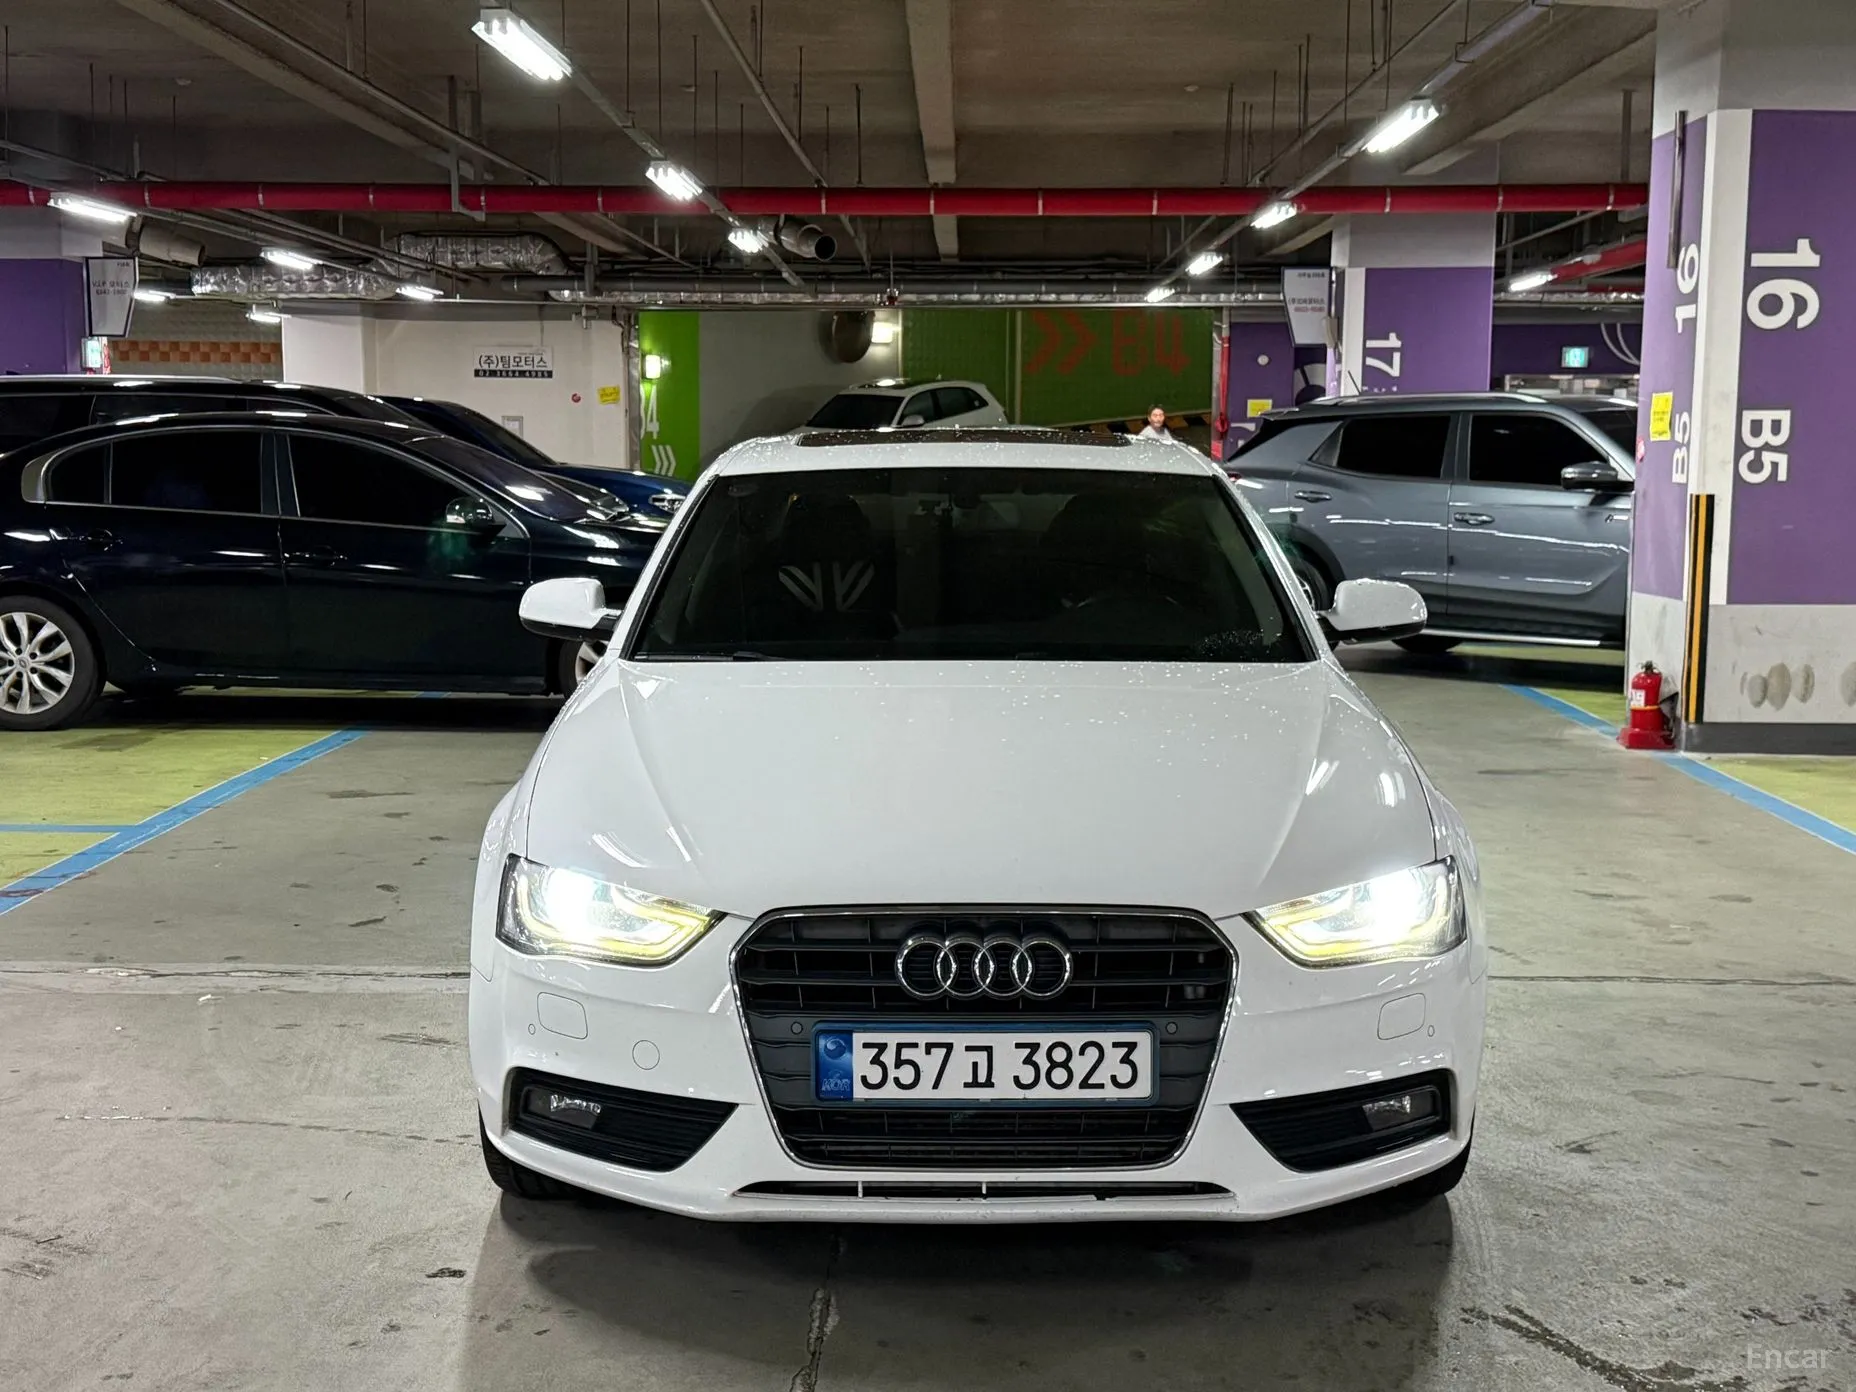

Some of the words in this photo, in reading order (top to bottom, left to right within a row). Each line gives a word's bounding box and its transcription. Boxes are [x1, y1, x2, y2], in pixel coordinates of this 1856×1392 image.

[1674, 243, 1700, 334] 16
[1746, 238, 1821, 330] 16
[1113, 309, 1191, 376] B4
[1365, 332, 1402, 377] 17
[1671, 411, 1691, 484] B5
[1738, 409, 1792, 484] B5
[860, 1041, 996, 1091] 357고
[1012, 1041, 1139, 1091] 3823
